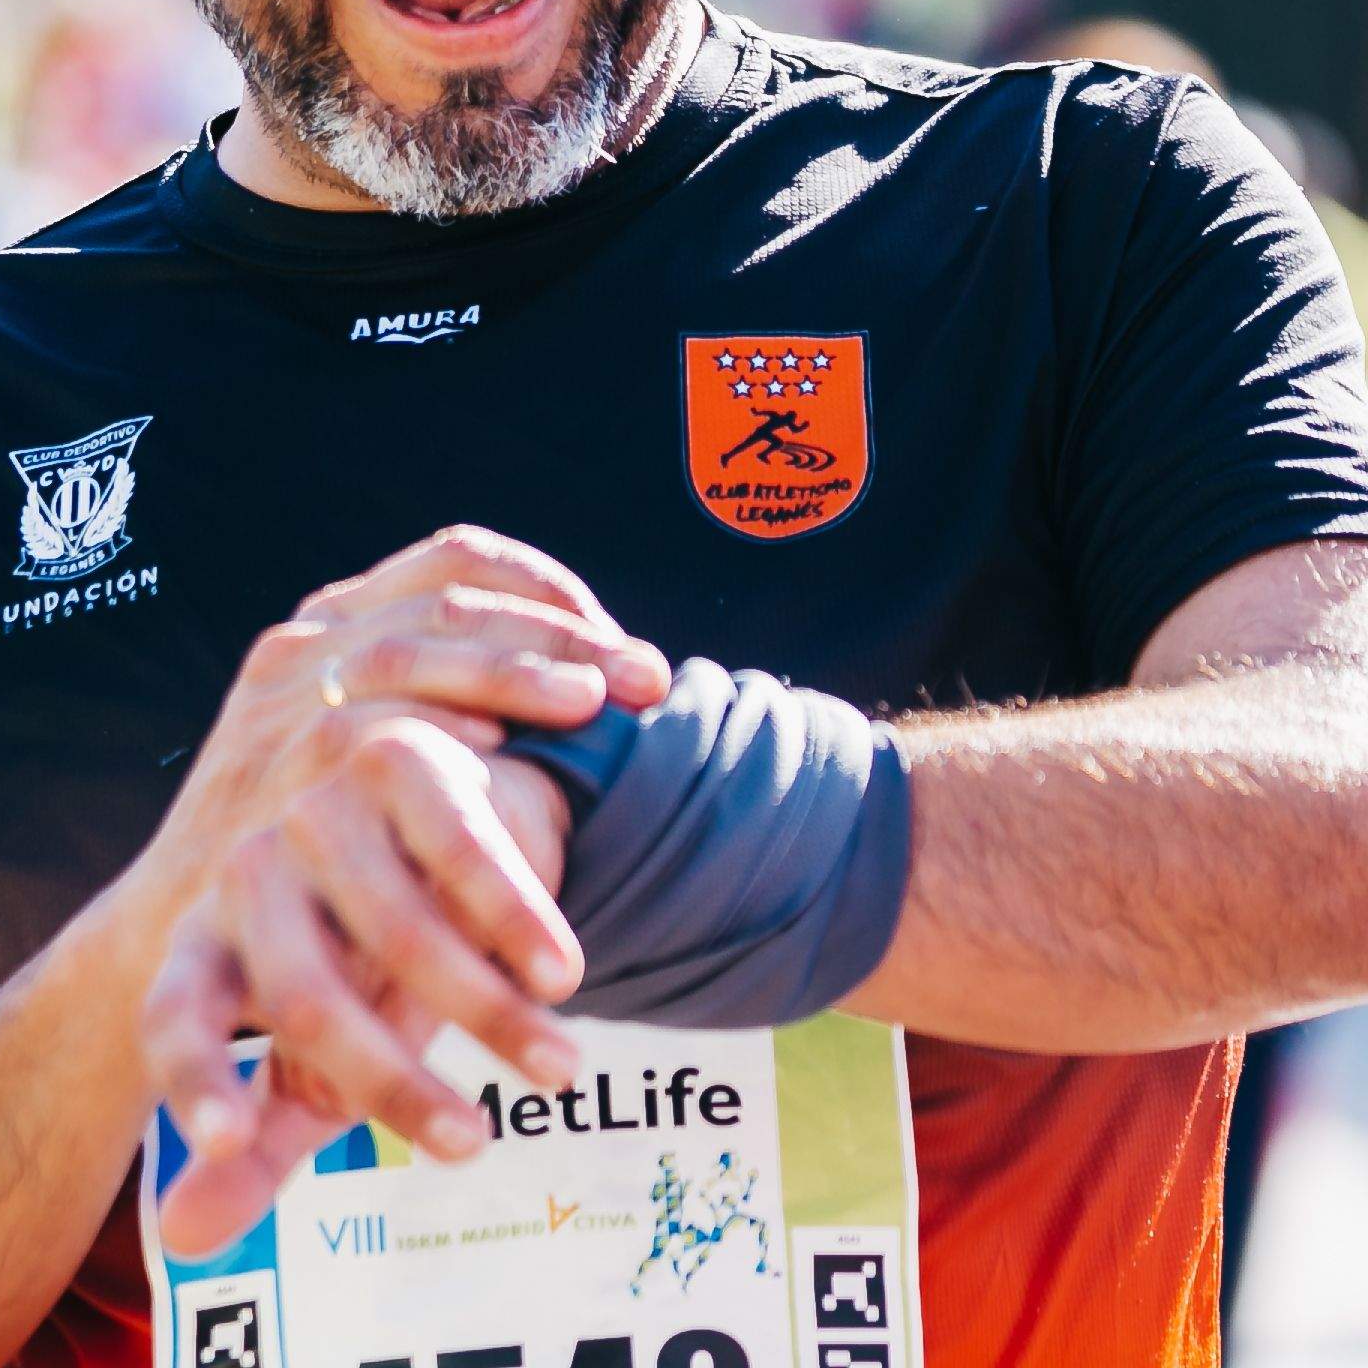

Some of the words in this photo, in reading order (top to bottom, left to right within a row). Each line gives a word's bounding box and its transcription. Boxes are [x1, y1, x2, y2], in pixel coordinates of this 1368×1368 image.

[350, 304, 481, 341] AMURA
[23, 451, 61, 465] CLUB
[64, 425, 136, 458] DEPORTIVO
[706, 482, 750, 499] CLUB
[753, 478, 852, 501] ATLETISMO
[318, 1214, 387, 1256] VIII
